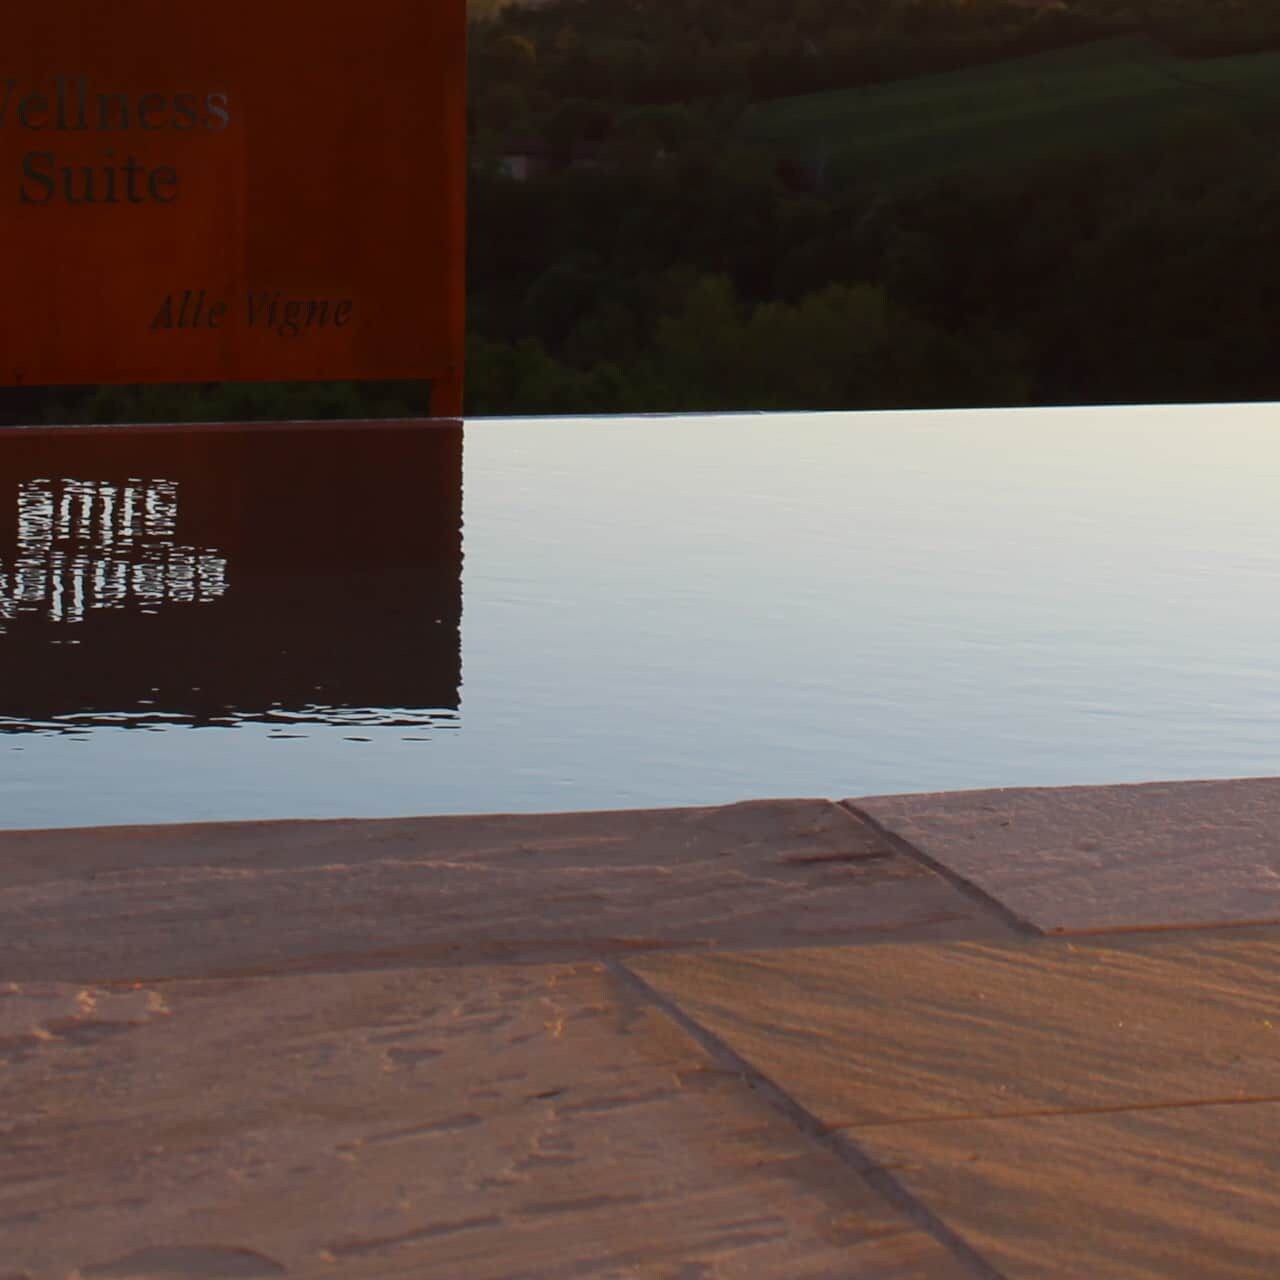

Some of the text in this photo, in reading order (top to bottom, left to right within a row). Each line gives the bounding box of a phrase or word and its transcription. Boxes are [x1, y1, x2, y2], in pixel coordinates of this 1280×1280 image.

[21, 151, 179, 205] Suite
[151, 289, 354, 337] Alle Vigne
